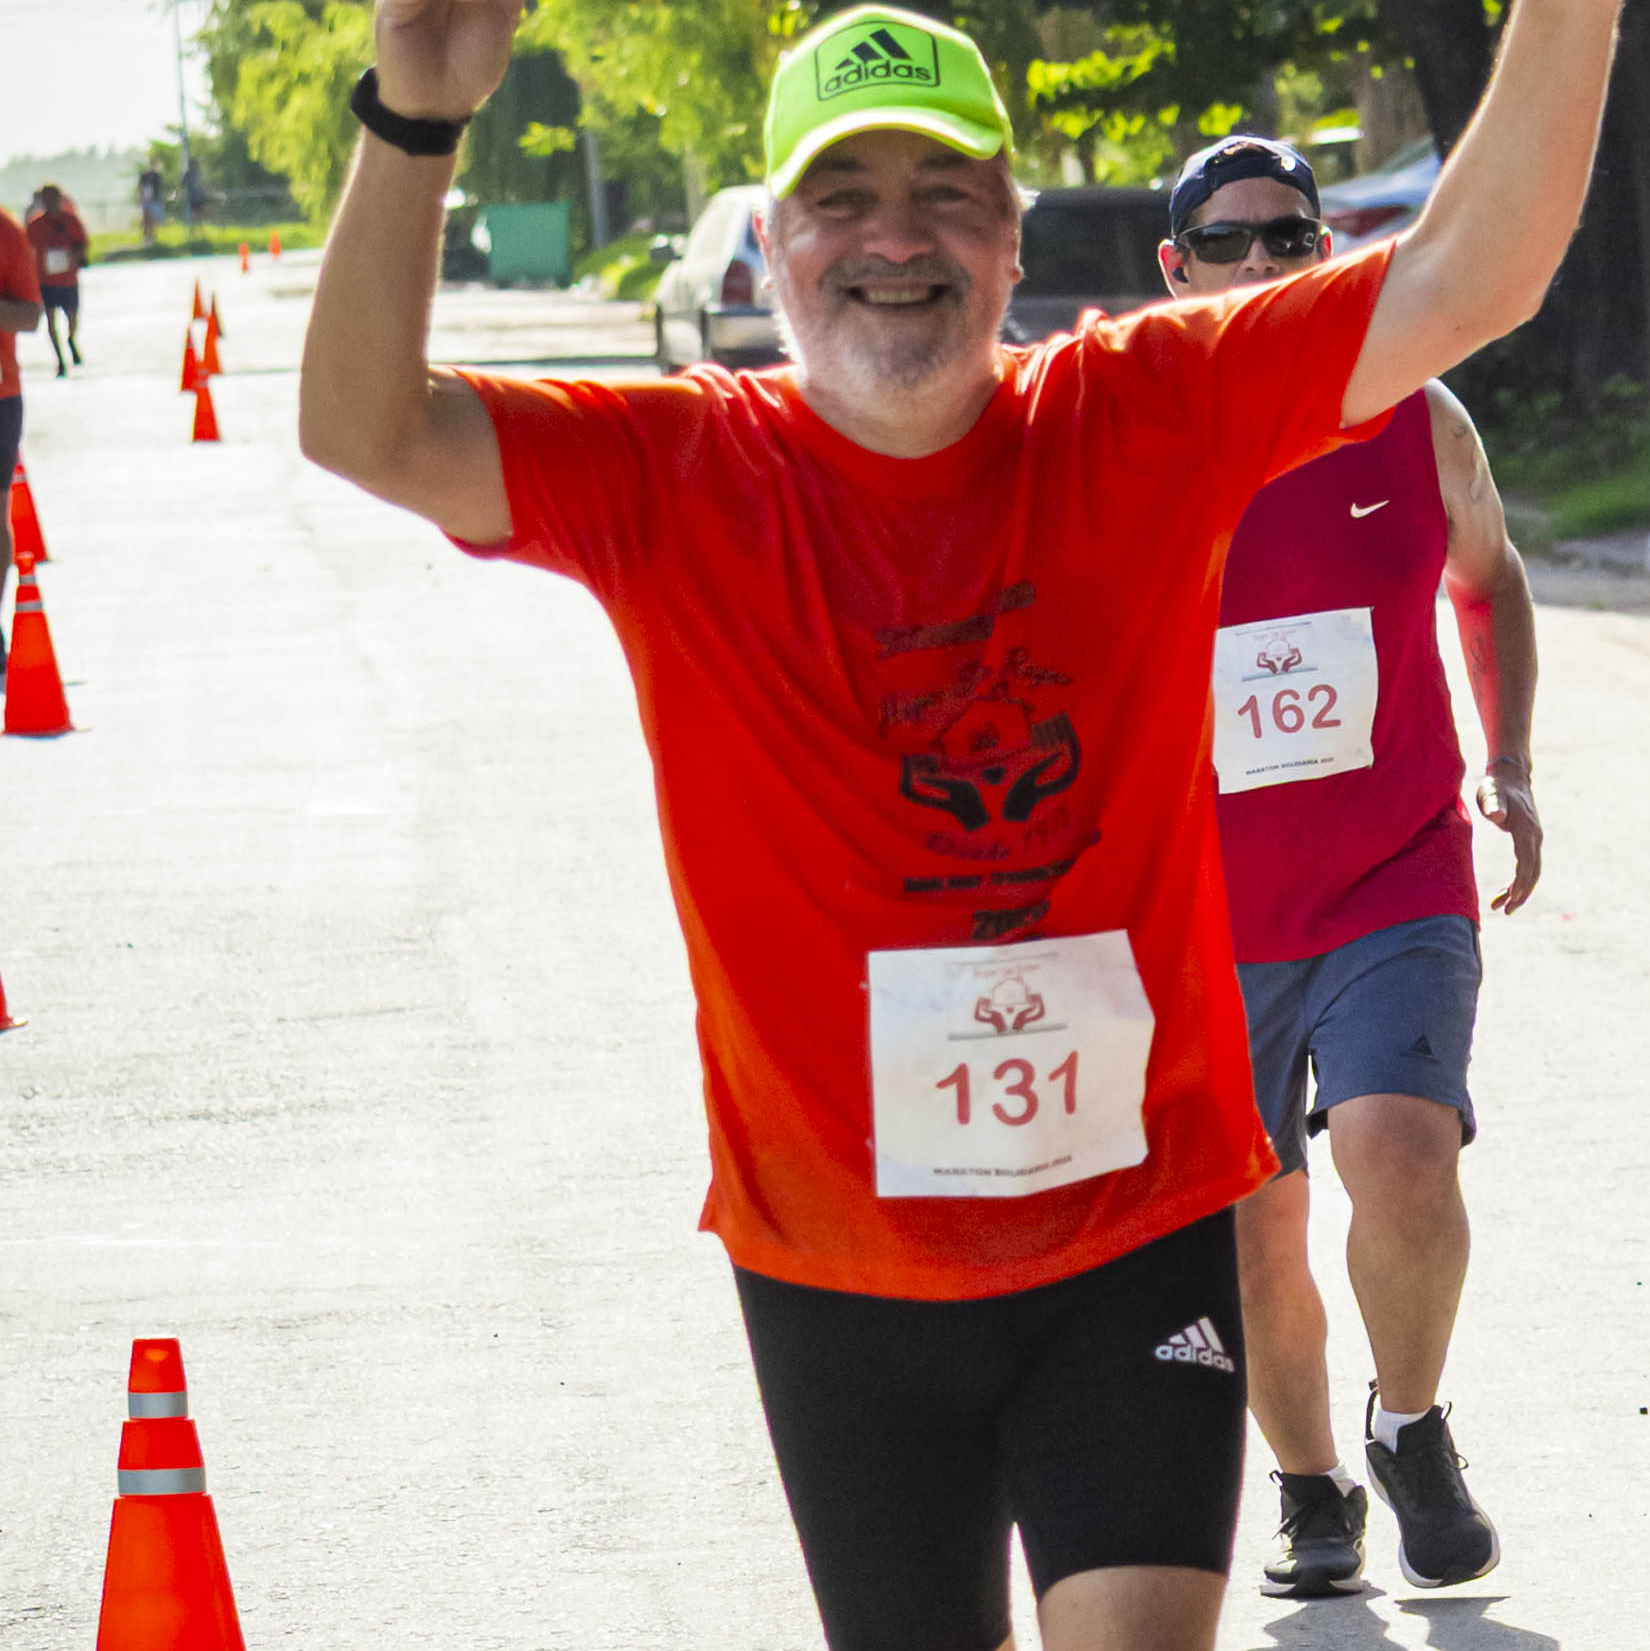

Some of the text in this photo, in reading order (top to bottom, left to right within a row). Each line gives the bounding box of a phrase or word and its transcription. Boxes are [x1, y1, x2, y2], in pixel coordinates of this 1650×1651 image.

[824, 59, 932, 92] adidas
[1238, 684, 1341, 739] 162
[935, 1050, 1078, 1126] 131
[1155, 1343, 1235, 1373] adidas
